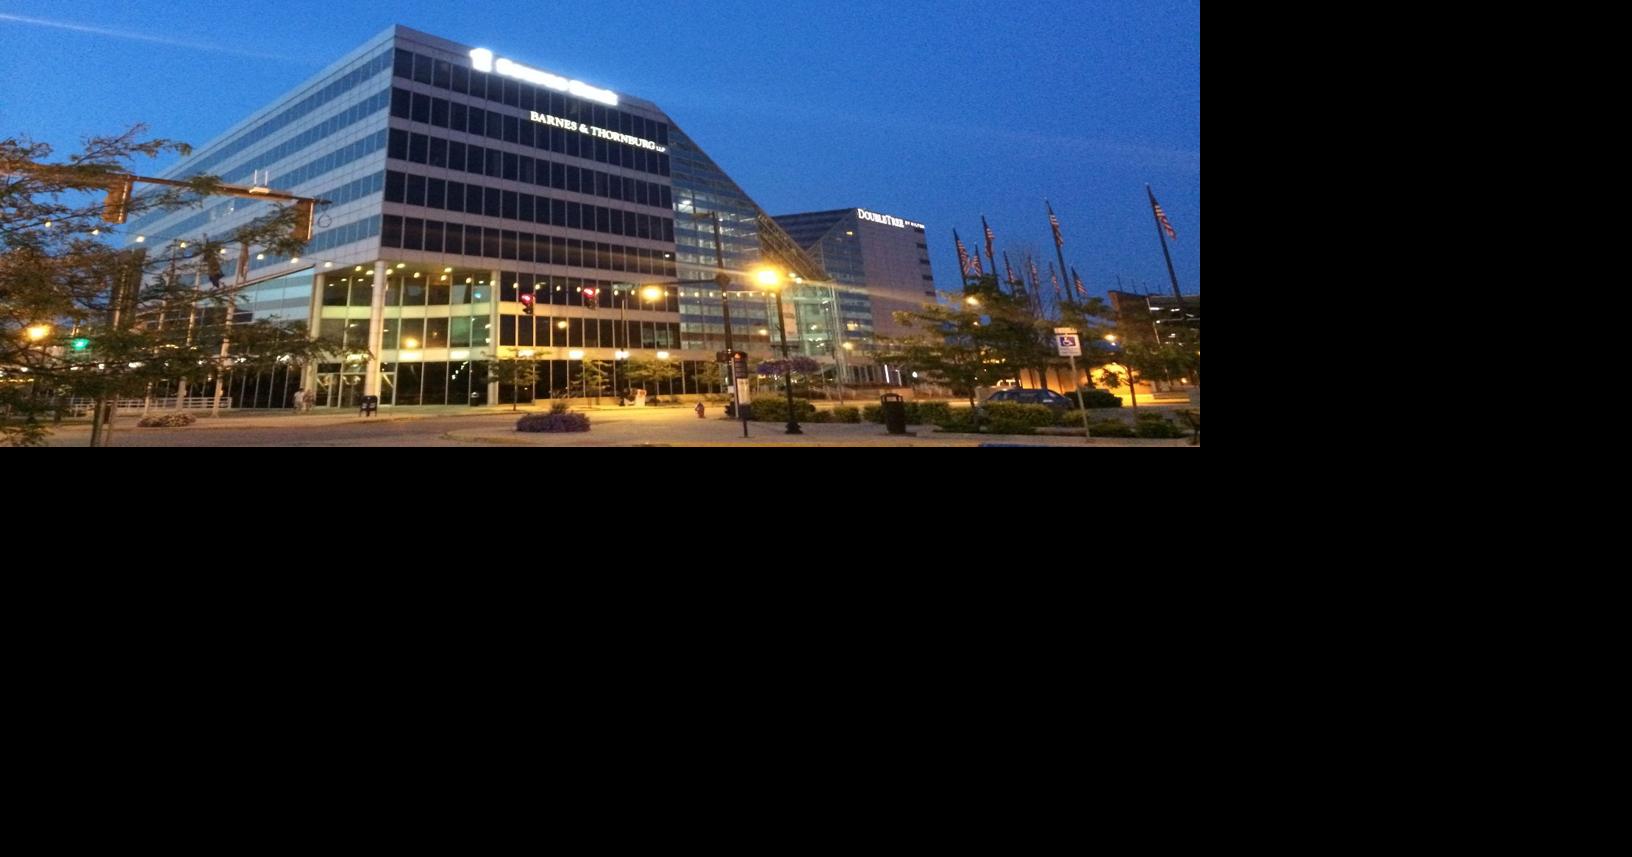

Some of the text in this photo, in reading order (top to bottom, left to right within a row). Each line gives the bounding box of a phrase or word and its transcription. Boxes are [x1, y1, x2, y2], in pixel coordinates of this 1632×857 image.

[530, 111, 577, 131] BARNES
[579, 123, 589, 134] &
[590, 126, 656, 150] THORNBURG
